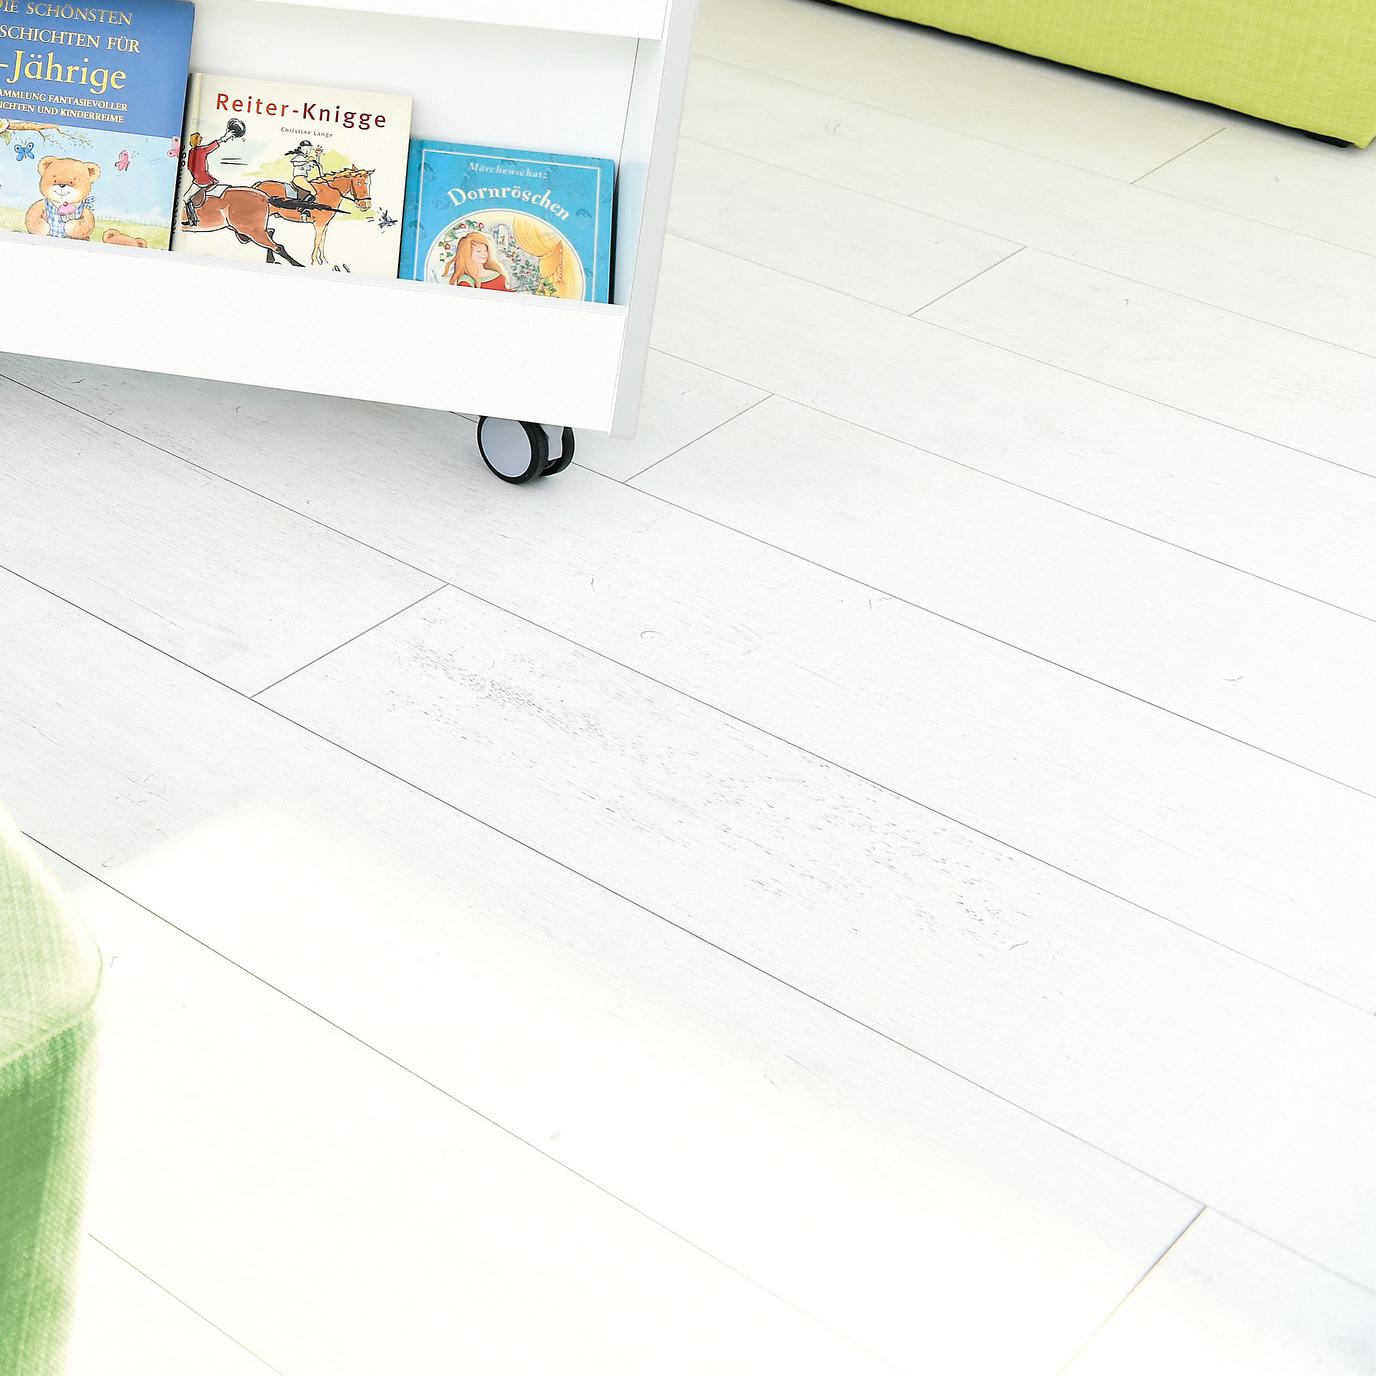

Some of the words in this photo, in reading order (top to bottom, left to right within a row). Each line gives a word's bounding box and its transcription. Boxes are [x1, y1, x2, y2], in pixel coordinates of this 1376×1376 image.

[48, 95, 128, 111] FANTASIEVOLLER
[215, 93, 386, 130] Reiter-Knigge
[37, 105, 58, 116] UND
[60, 106, 124, 123] KINDERREIME
[280, 126, 311, 135] Christine
[313, 130, 333, 138] Lange
[447, 185, 570, 221] Dornröschen
